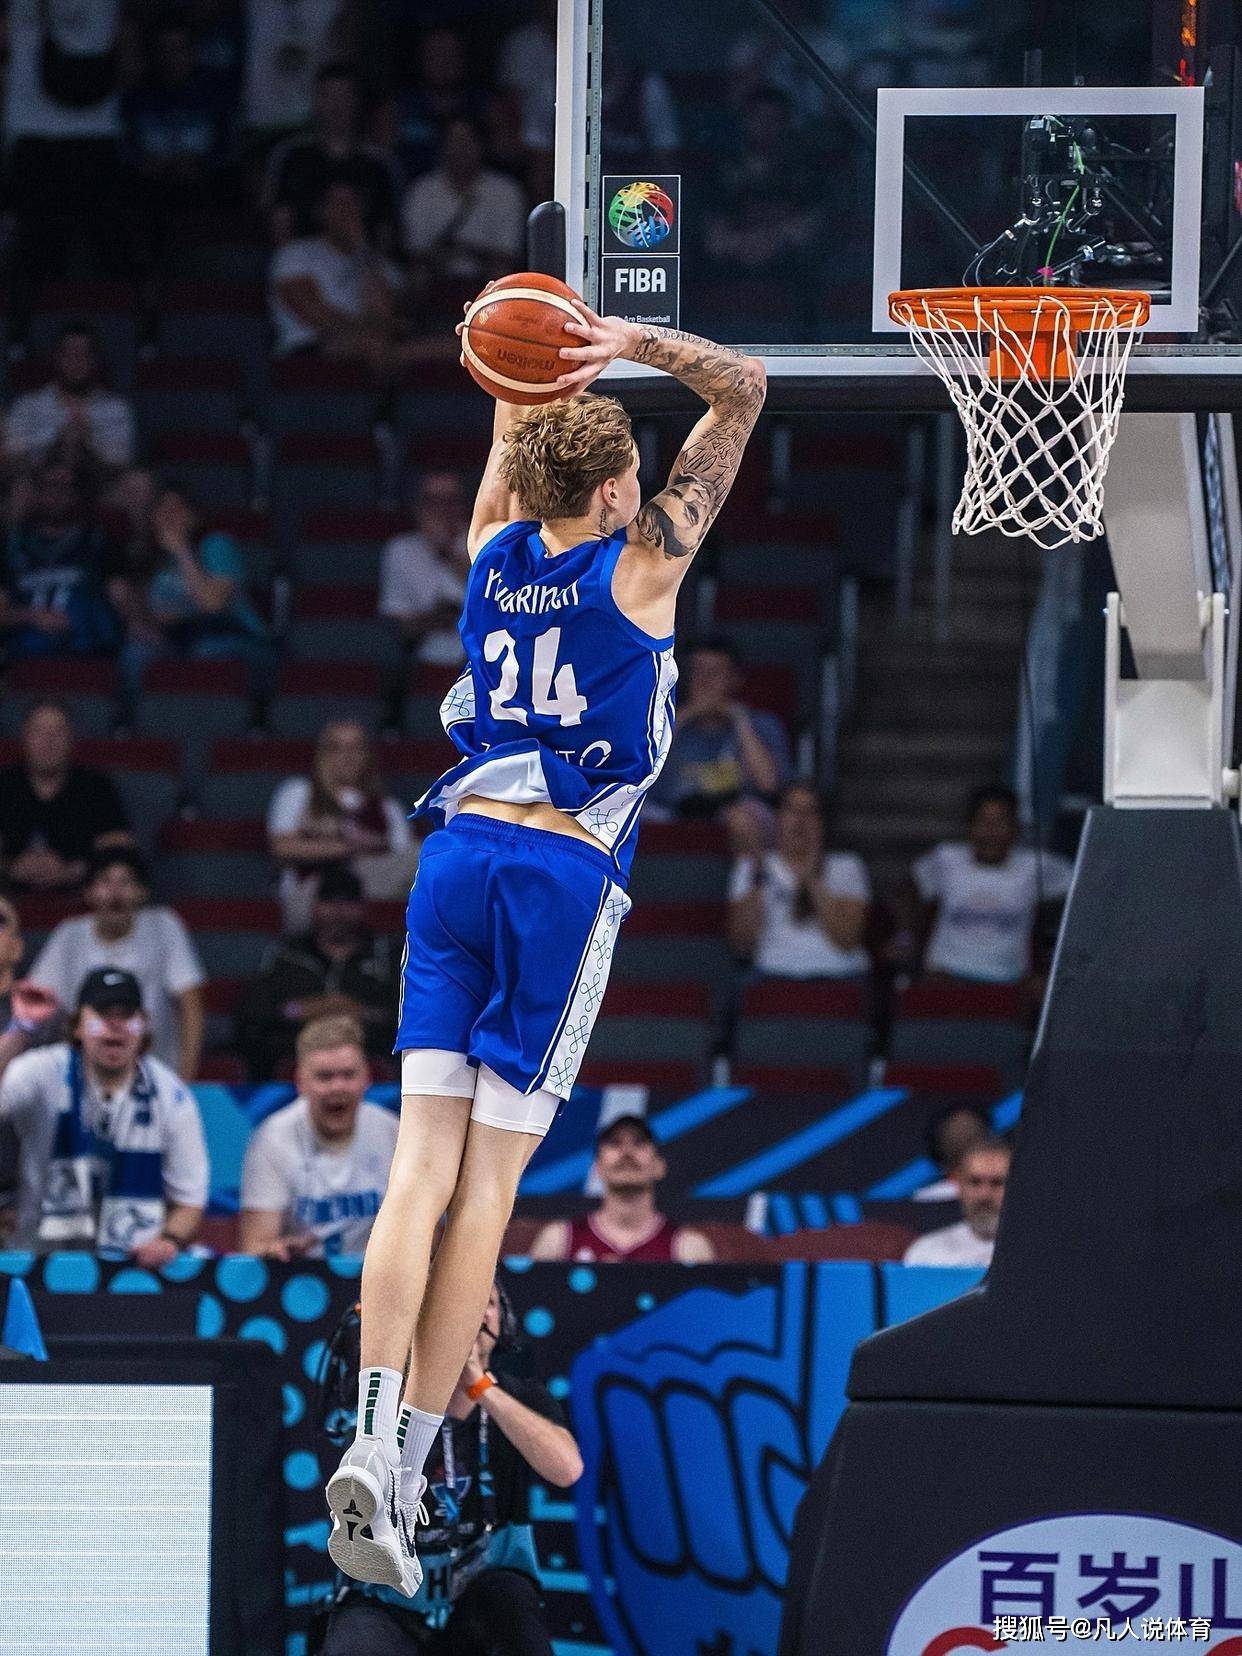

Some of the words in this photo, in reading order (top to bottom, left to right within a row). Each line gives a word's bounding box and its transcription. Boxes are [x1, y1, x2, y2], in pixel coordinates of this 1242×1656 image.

[615, 267, 667, 293] FIBA
[624, 315, 635, 323] Are
[636, 315, 671, 323] Basketball
[497, 348, 555, 371] molten
[483, 626, 588, 728] 24
[978, 1551, 1242, 1630] 百岁山
